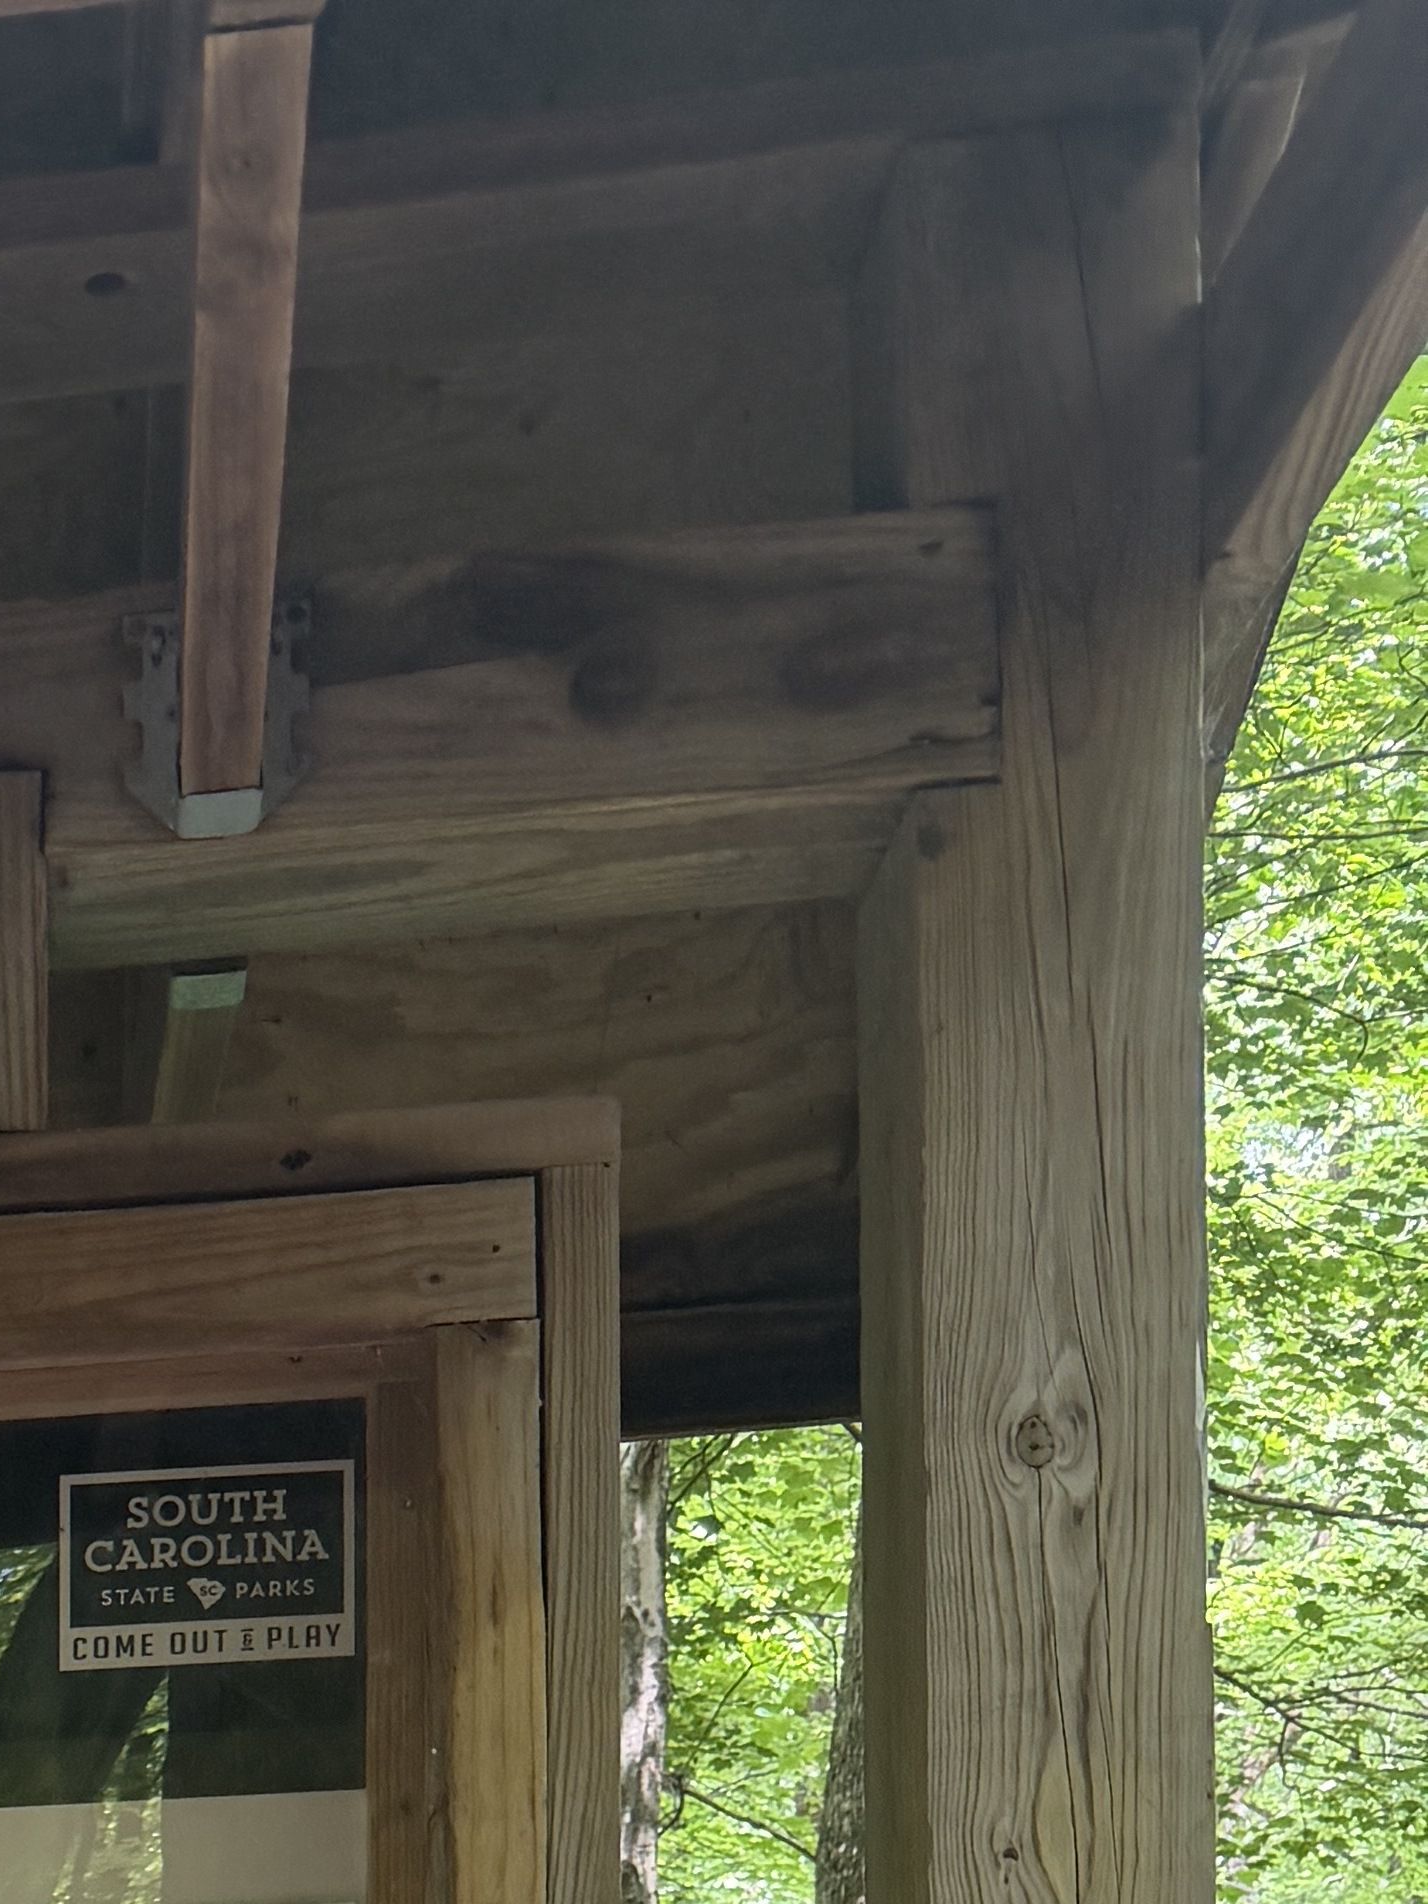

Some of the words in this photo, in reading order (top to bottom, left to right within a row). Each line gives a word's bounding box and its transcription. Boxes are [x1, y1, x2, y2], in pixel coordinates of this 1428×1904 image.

[127, 1489, 287, 1528] SOUTH
[84, 1529, 329, 1572] CAROLINA
[101, 1586, 175, 1606] STATE
[200, 1586, 217, 1596] SC
[236, 1579, 315, 1598] PARKS
[73, 1633, 153, 1660] COME
[170, 1629, 227, 1655] OUT
[267, 1623, 340, 1649] PLAY
